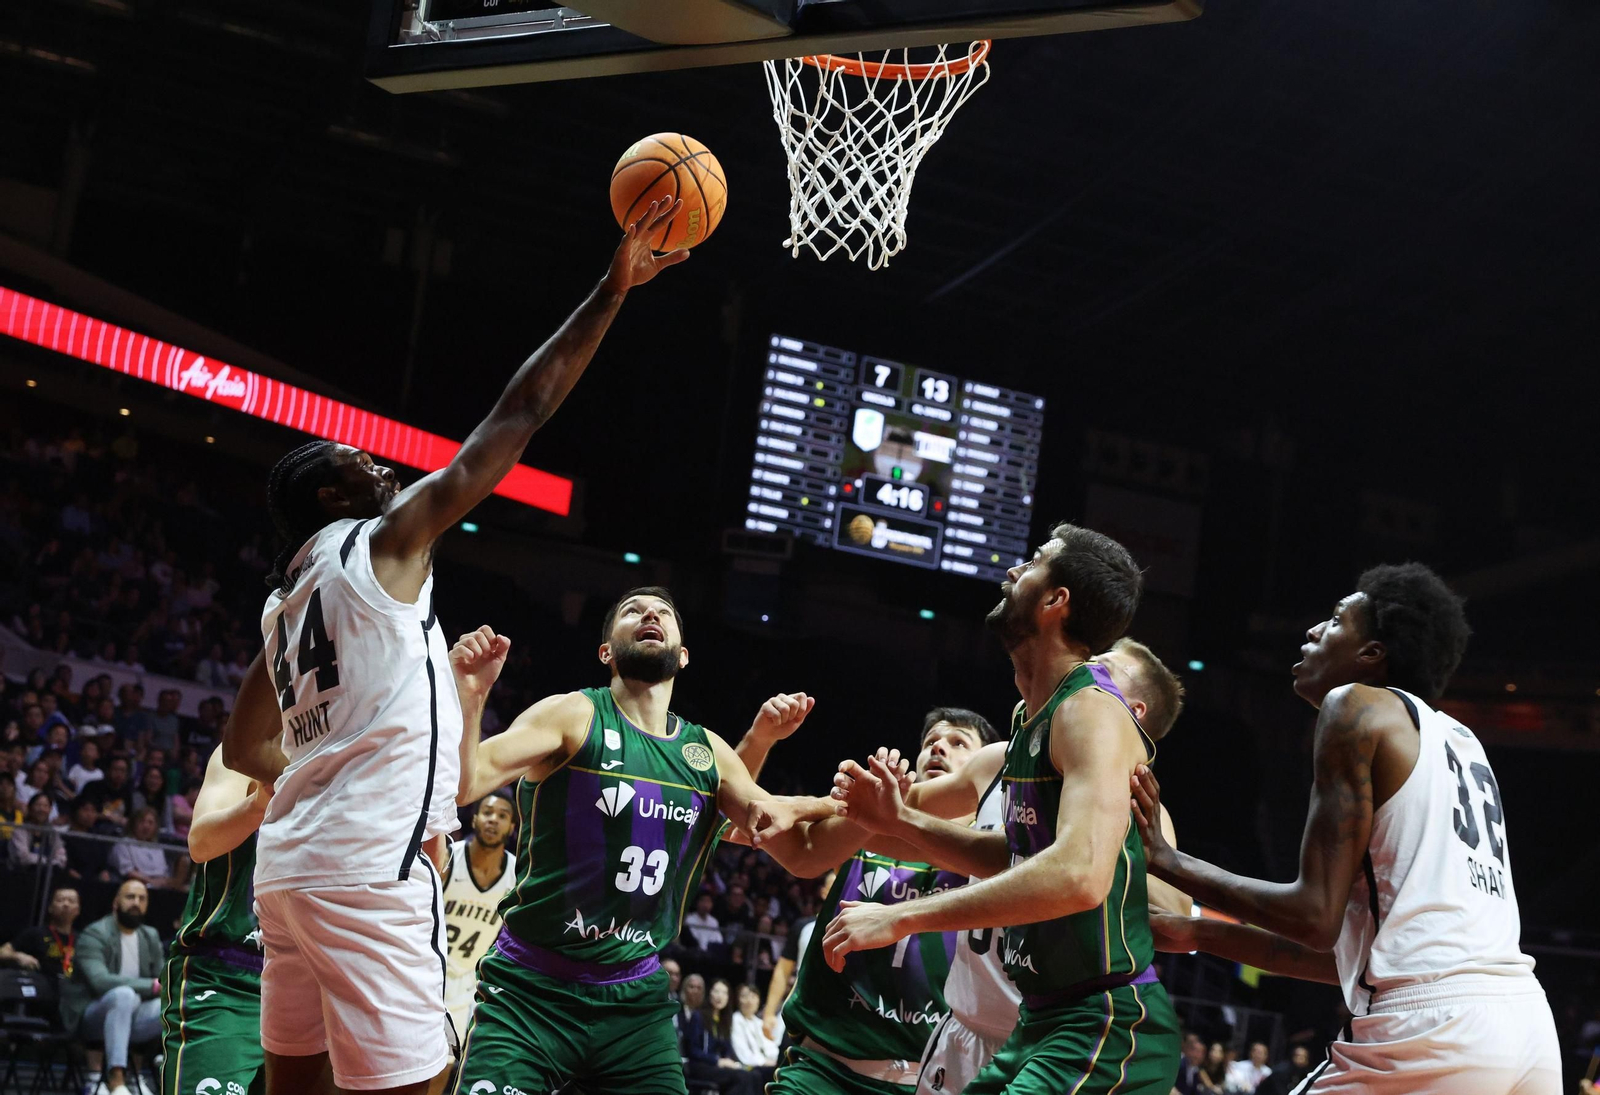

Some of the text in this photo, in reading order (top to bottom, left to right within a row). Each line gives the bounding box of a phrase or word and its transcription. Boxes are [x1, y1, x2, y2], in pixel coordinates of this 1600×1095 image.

[874, 364, 891, 388] 7
[922, 377, 950, 403] 13
[876, 483, 923, 512] 4:16
[273, 587, 340, 713] 44
[288, 701, 331, 748] HUNT
[1445, 740, 1504, 869] 32
[615, 845, 669, 896] 33
[444, 900, 500, 926] UNITED
